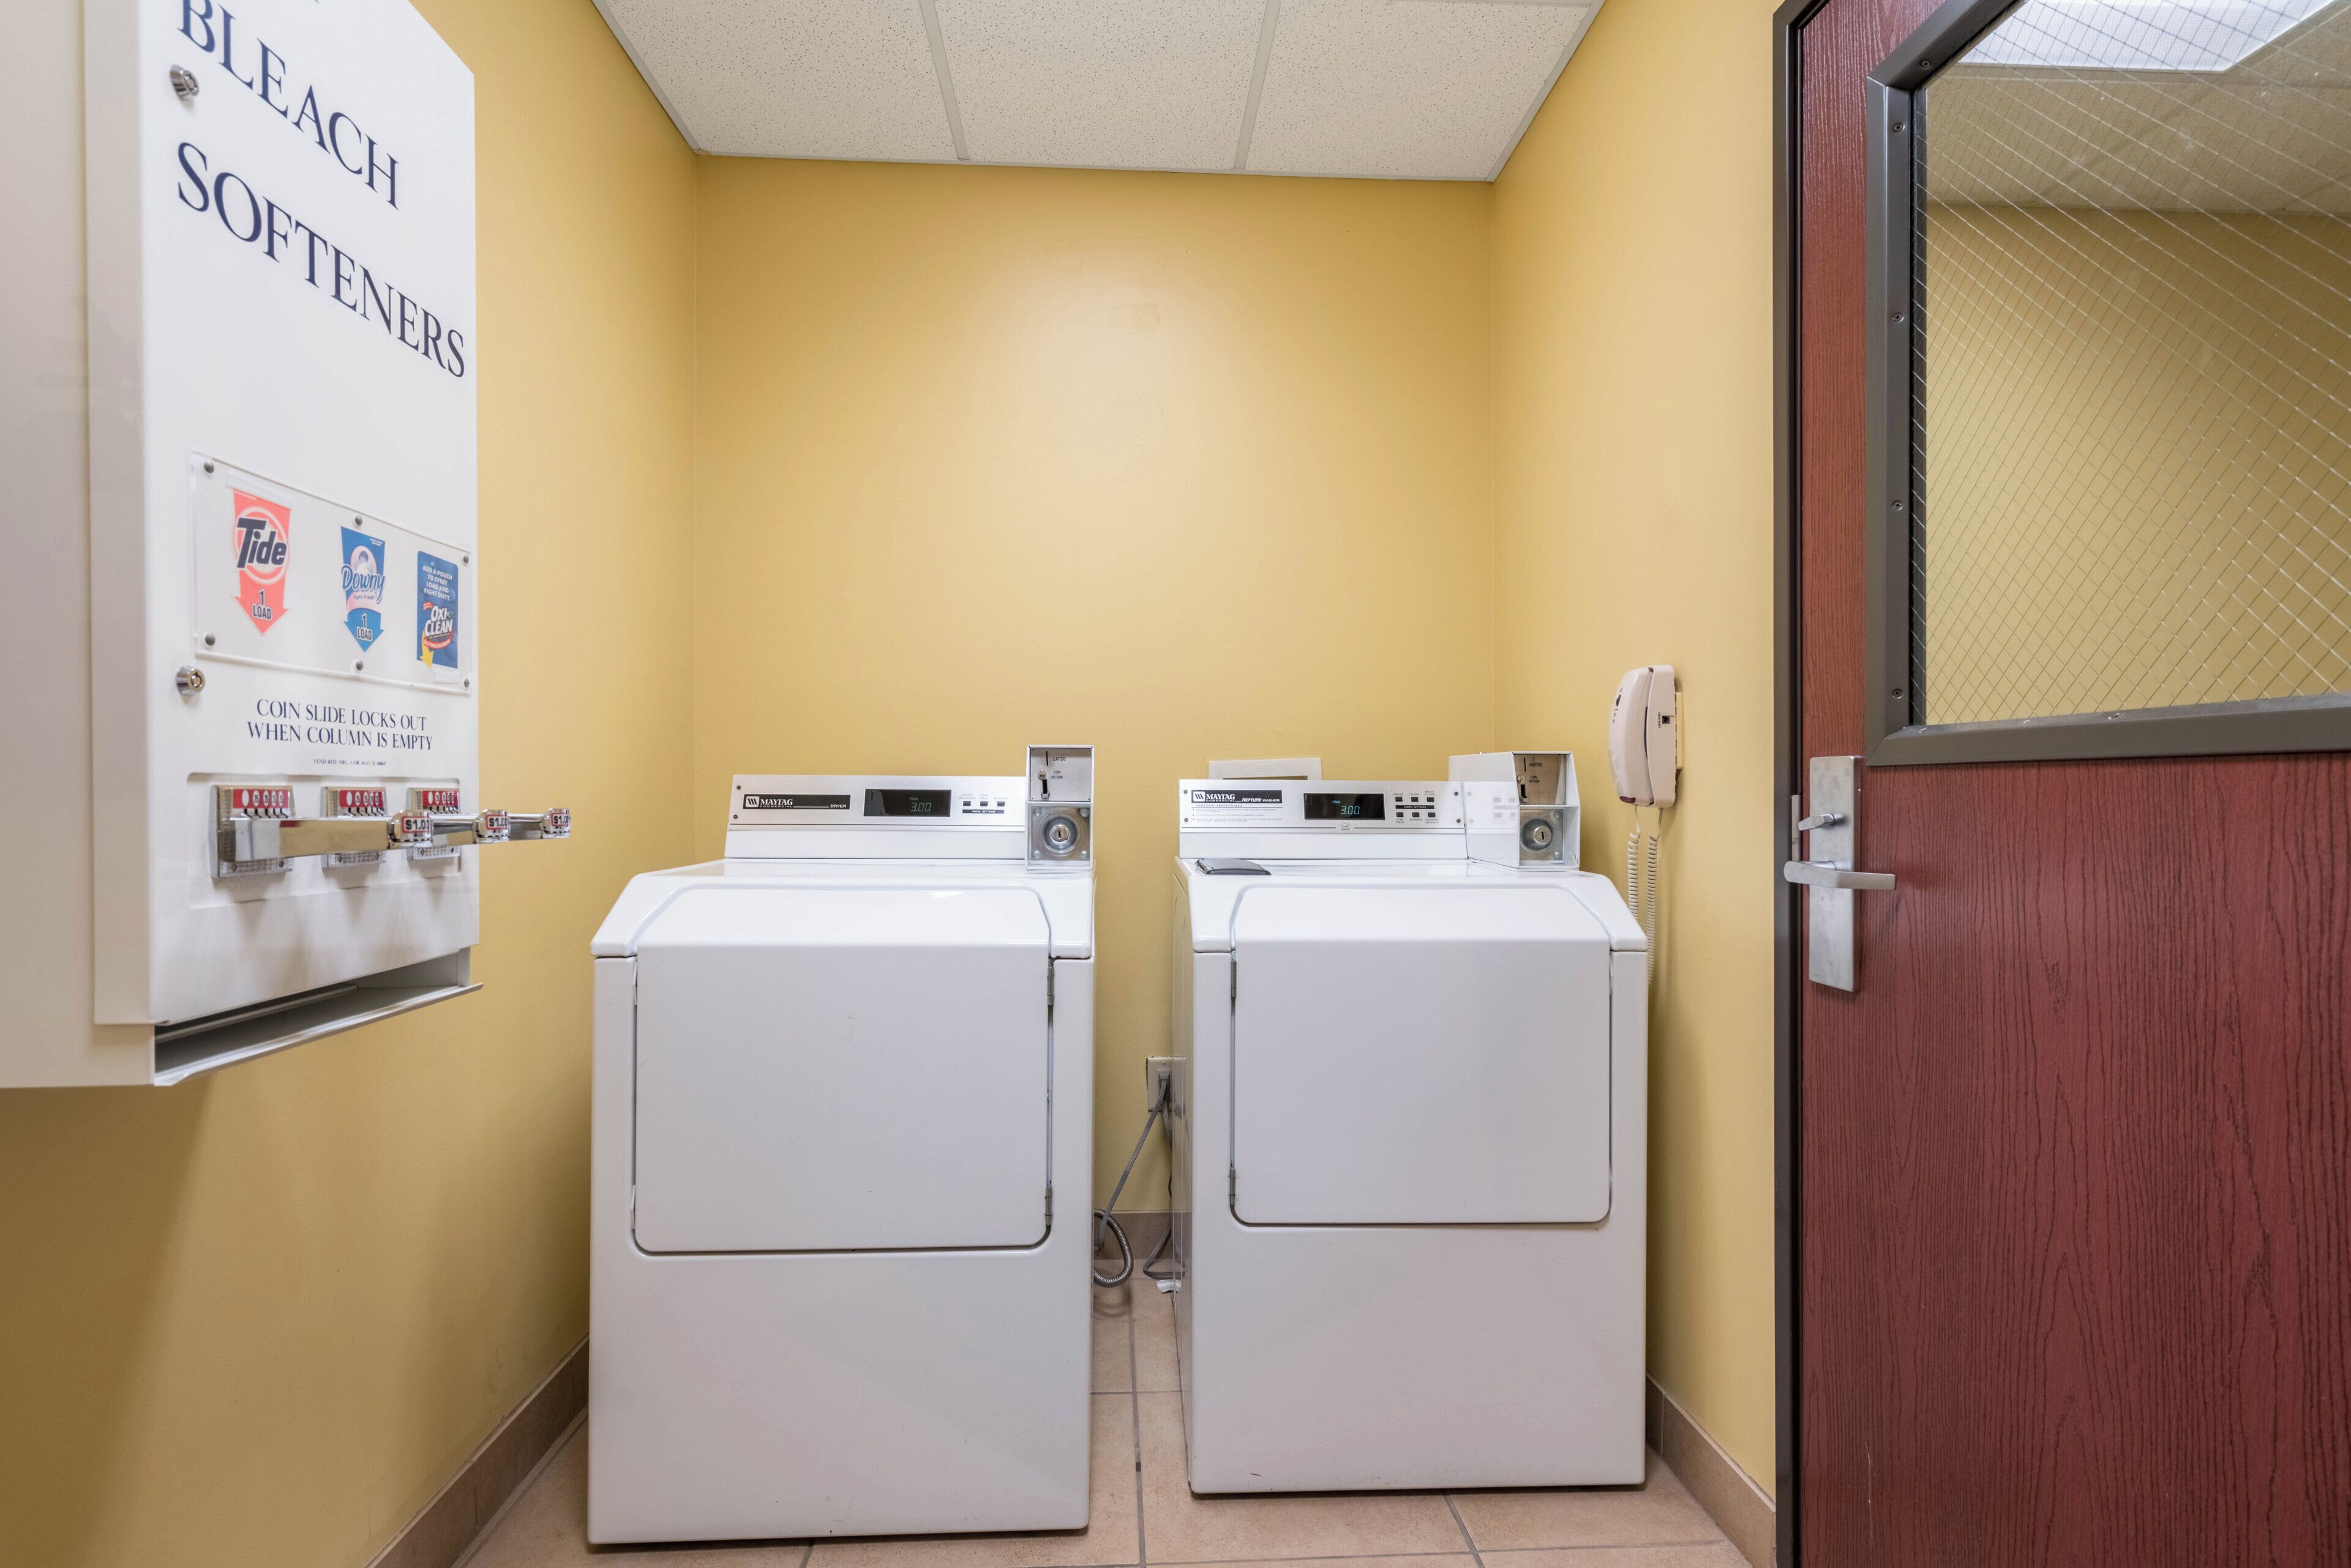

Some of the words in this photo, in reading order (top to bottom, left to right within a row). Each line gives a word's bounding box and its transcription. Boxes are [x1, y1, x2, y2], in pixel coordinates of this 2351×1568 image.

[178, 0, 399, 211] BLEACH
[178, 141, 465, 378] SOFTENERS
[236, 517, 288, 568] Tide
[422, 565, 432, 573] ADD
[437, 570, 452, 580] POUCH
[340, 564, 386, 604] Downy
[426, 581, 438, 590] LOAD
[434, 576, 448, 586] EVERY
[259, 590, 264, 606] 1
[424, 587, 437, 596] FIGHT
[437, 592, 451, 601] DIRTY.
[252, 605, 271, 620] LOAD
[431, 605, 448, 622] OXI
[361, 614, 367, 628] 1
[424, 618, 453, 637] CLEAN
[357, 628, 372, 640] LOAD
[256, 699, 301, 719] COIN
[306, 704, 347, 724] SLIDE
[351, 710, 396, 729] LOCKS
[400, 715, 427, 731] OUT
[247, 721, 301, 742] WHEN
[307, 726, 372, 747] COLUMN
[377, 732, 388, 748] IS
[392, 733, 433, 751] EMPTY
[910, 802, 932, 812] 3.00
[1341, 805, 1360, 814] 3.00
